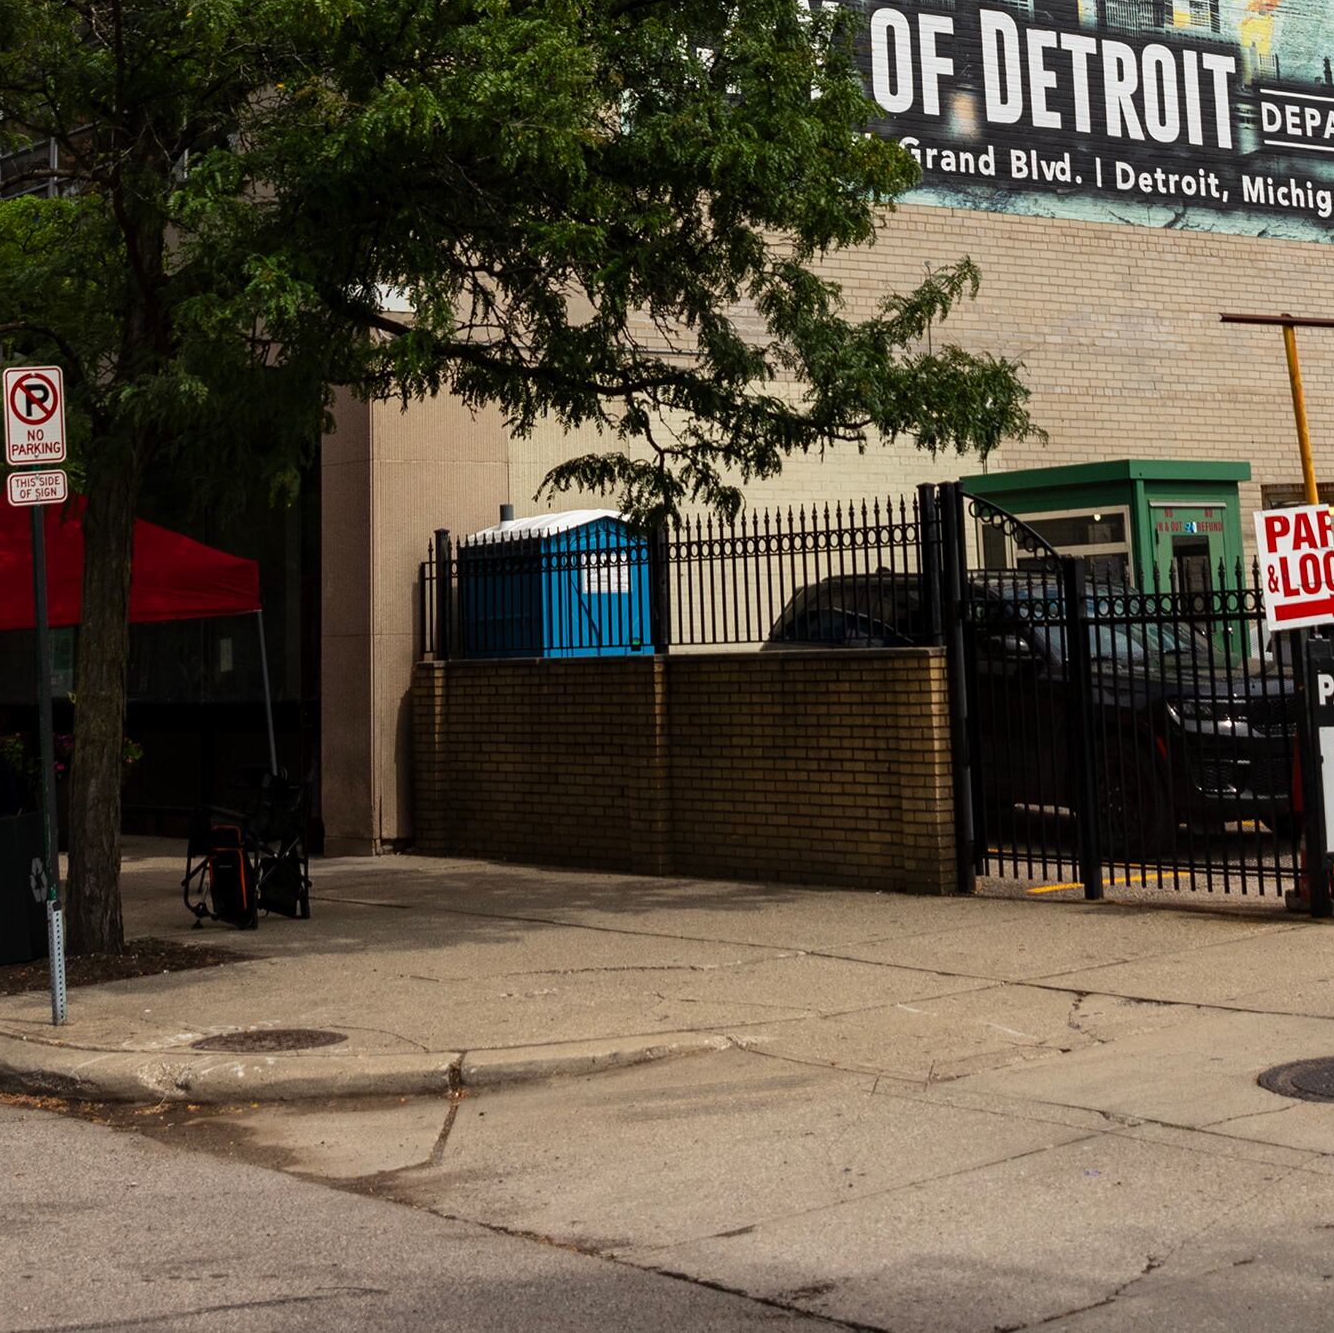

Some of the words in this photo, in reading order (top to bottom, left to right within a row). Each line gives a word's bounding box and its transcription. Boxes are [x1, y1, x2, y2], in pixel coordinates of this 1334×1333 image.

[870, 7, 955, 116] OF
[978, 8, 1236, 149] DETROIT
[1010, 149, 1083, 184] Blvd.
[1115, 161, 1230, 203] Detroit,
[27, 429, 44, 442] NO
[11, 441, 61, 456] PARKING
[15, 477, 36, 489] THIS
[38, 475, 61, 487] SIDE
[19, 489, 32, 500] OF
[35, 487, 57, 499] SIGN
